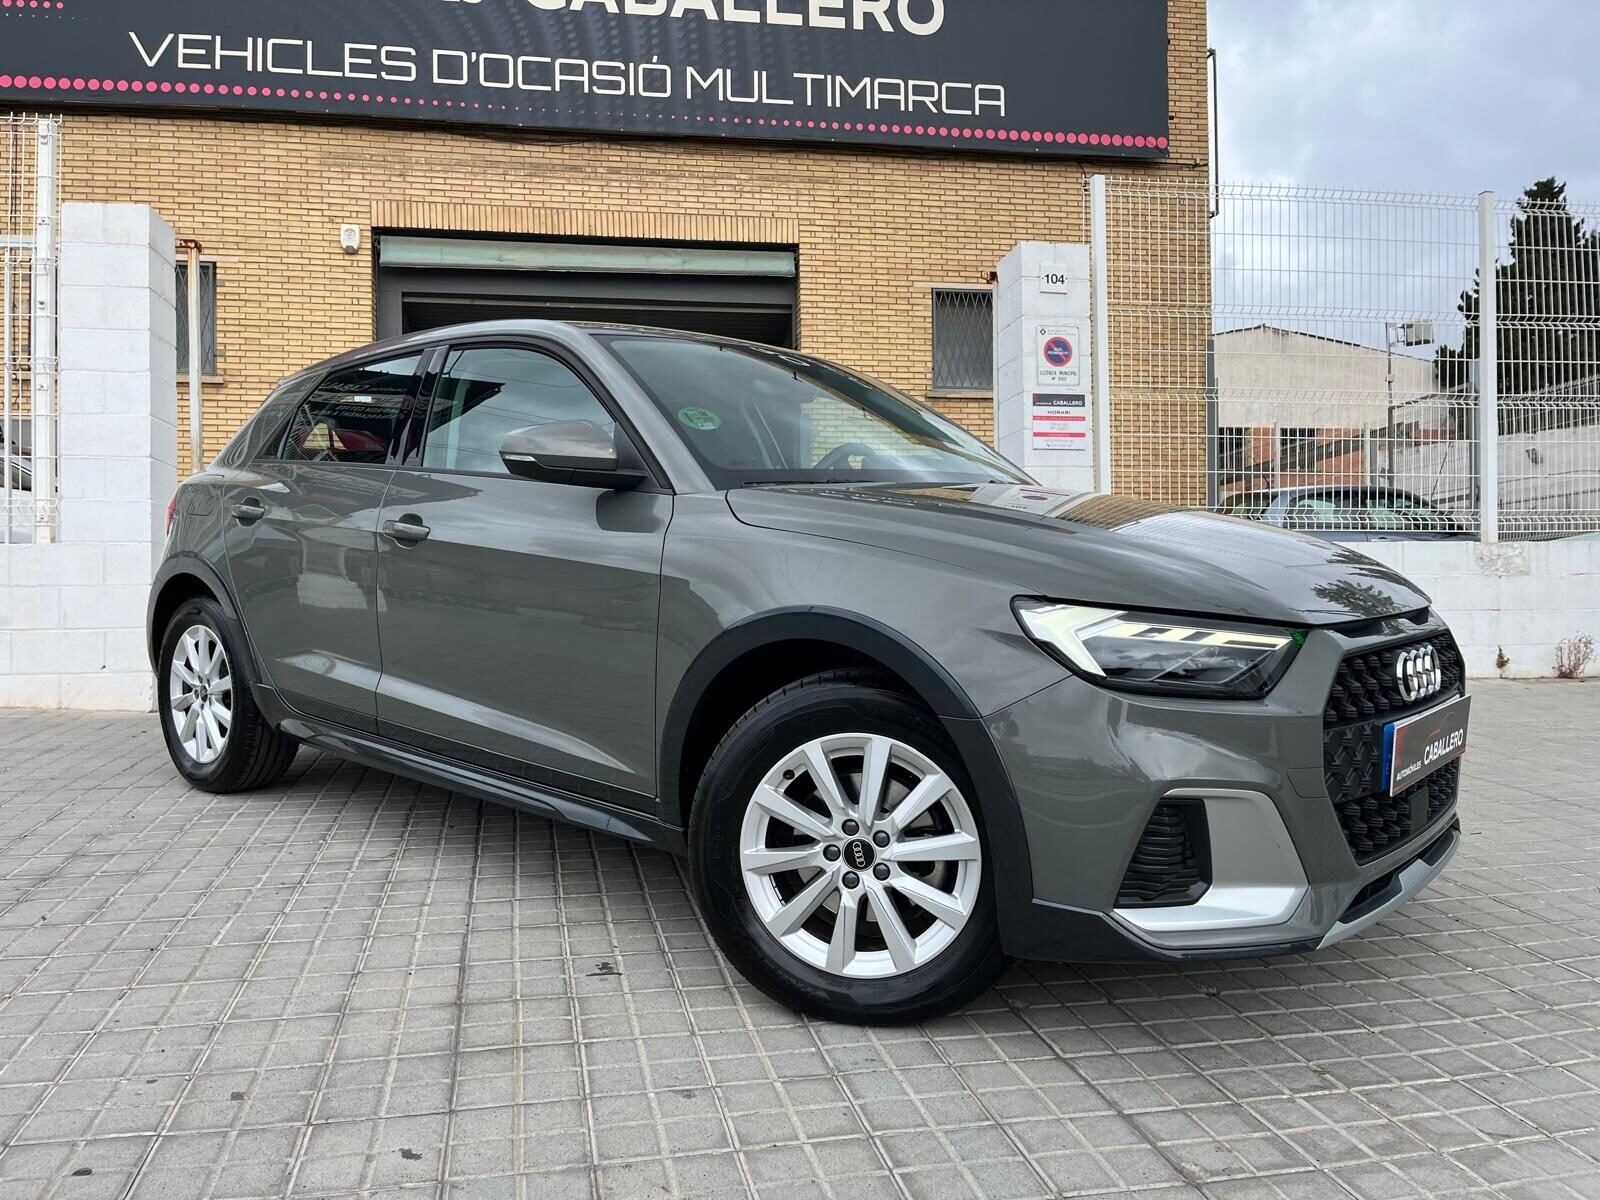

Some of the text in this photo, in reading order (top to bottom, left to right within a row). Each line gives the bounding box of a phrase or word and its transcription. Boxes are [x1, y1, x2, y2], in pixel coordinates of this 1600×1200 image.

[527, 0, 945, 36] LLERO
[128, 31, 1006, 117] VEHICLES D'OCASIÓ MULTIMARCA
[1423, 728, 1464, 765] CABALLERO
